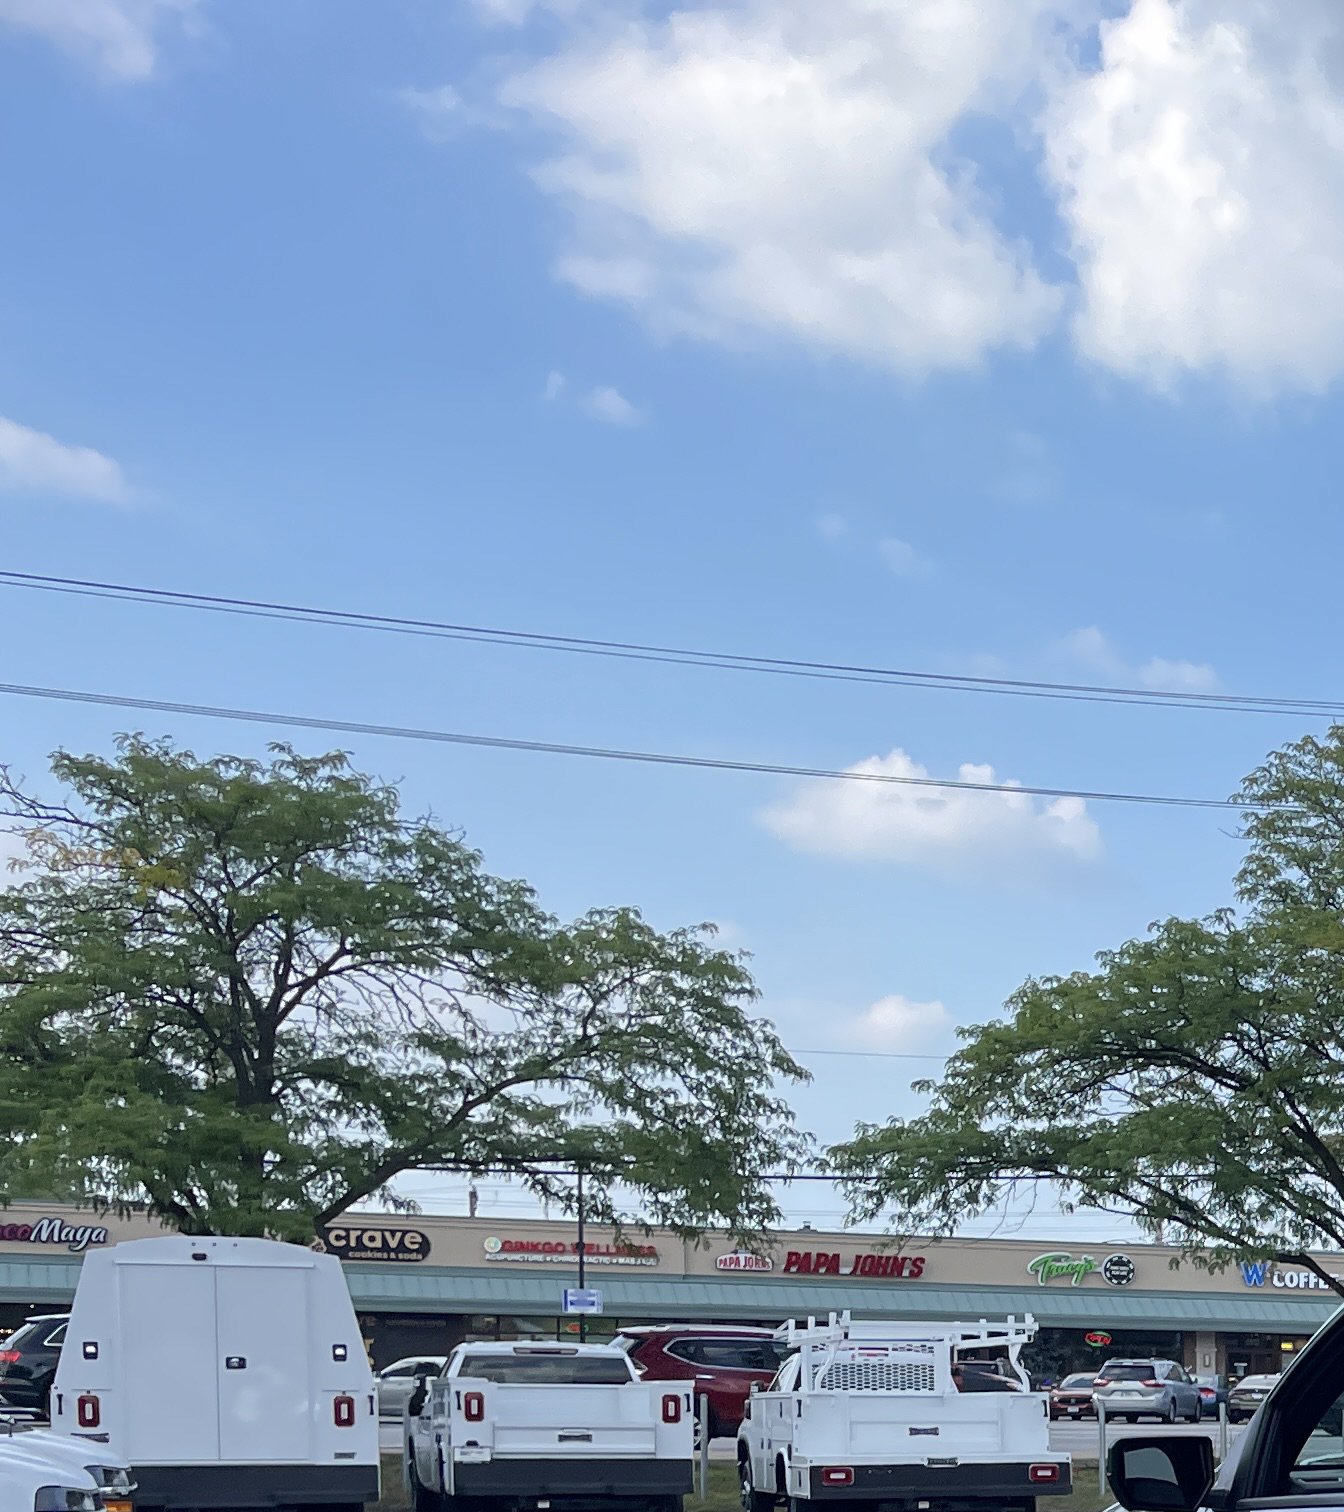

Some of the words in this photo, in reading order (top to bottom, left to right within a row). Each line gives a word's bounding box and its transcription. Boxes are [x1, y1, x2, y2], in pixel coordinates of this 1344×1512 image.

[29, 1217, 108, 1251] Maya
[328, 1229, 423, 1249] crave
[348, 1250, 388, 1259] cookies
[398, 1251, 423, 1260] soda
[502, 1240, 566, 1253] GINKGO
[719, 1256, 741, 1268] PAPA
[784, 1251, 841, 1274] PAPA
[850, 1254, 926, 1279] JOHN'S
[1272, 1271, 1340, 1290] COFFE
